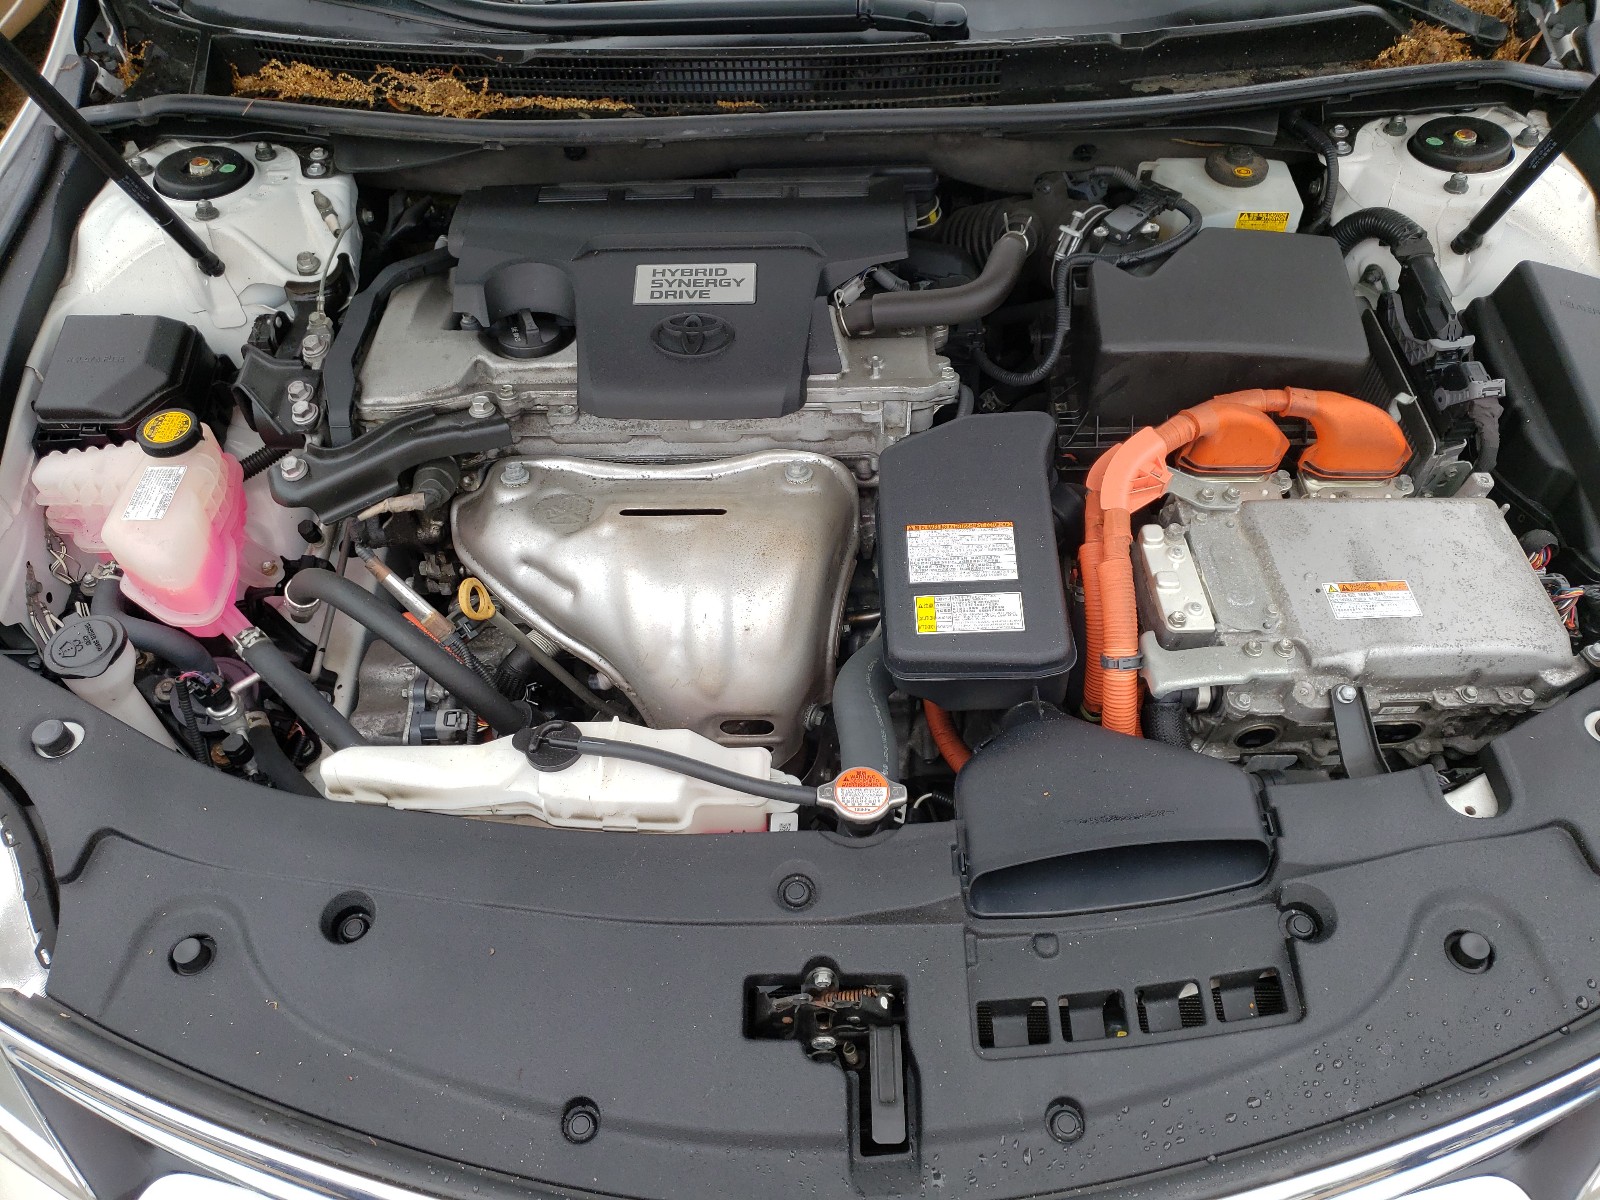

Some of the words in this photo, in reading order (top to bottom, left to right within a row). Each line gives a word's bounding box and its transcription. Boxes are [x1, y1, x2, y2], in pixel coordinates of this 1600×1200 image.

[652, 267, 728, 277] HYBRID
[650, 278, 746, 288] SYNERGY
[650, 289, 711, 300] DRIVE
